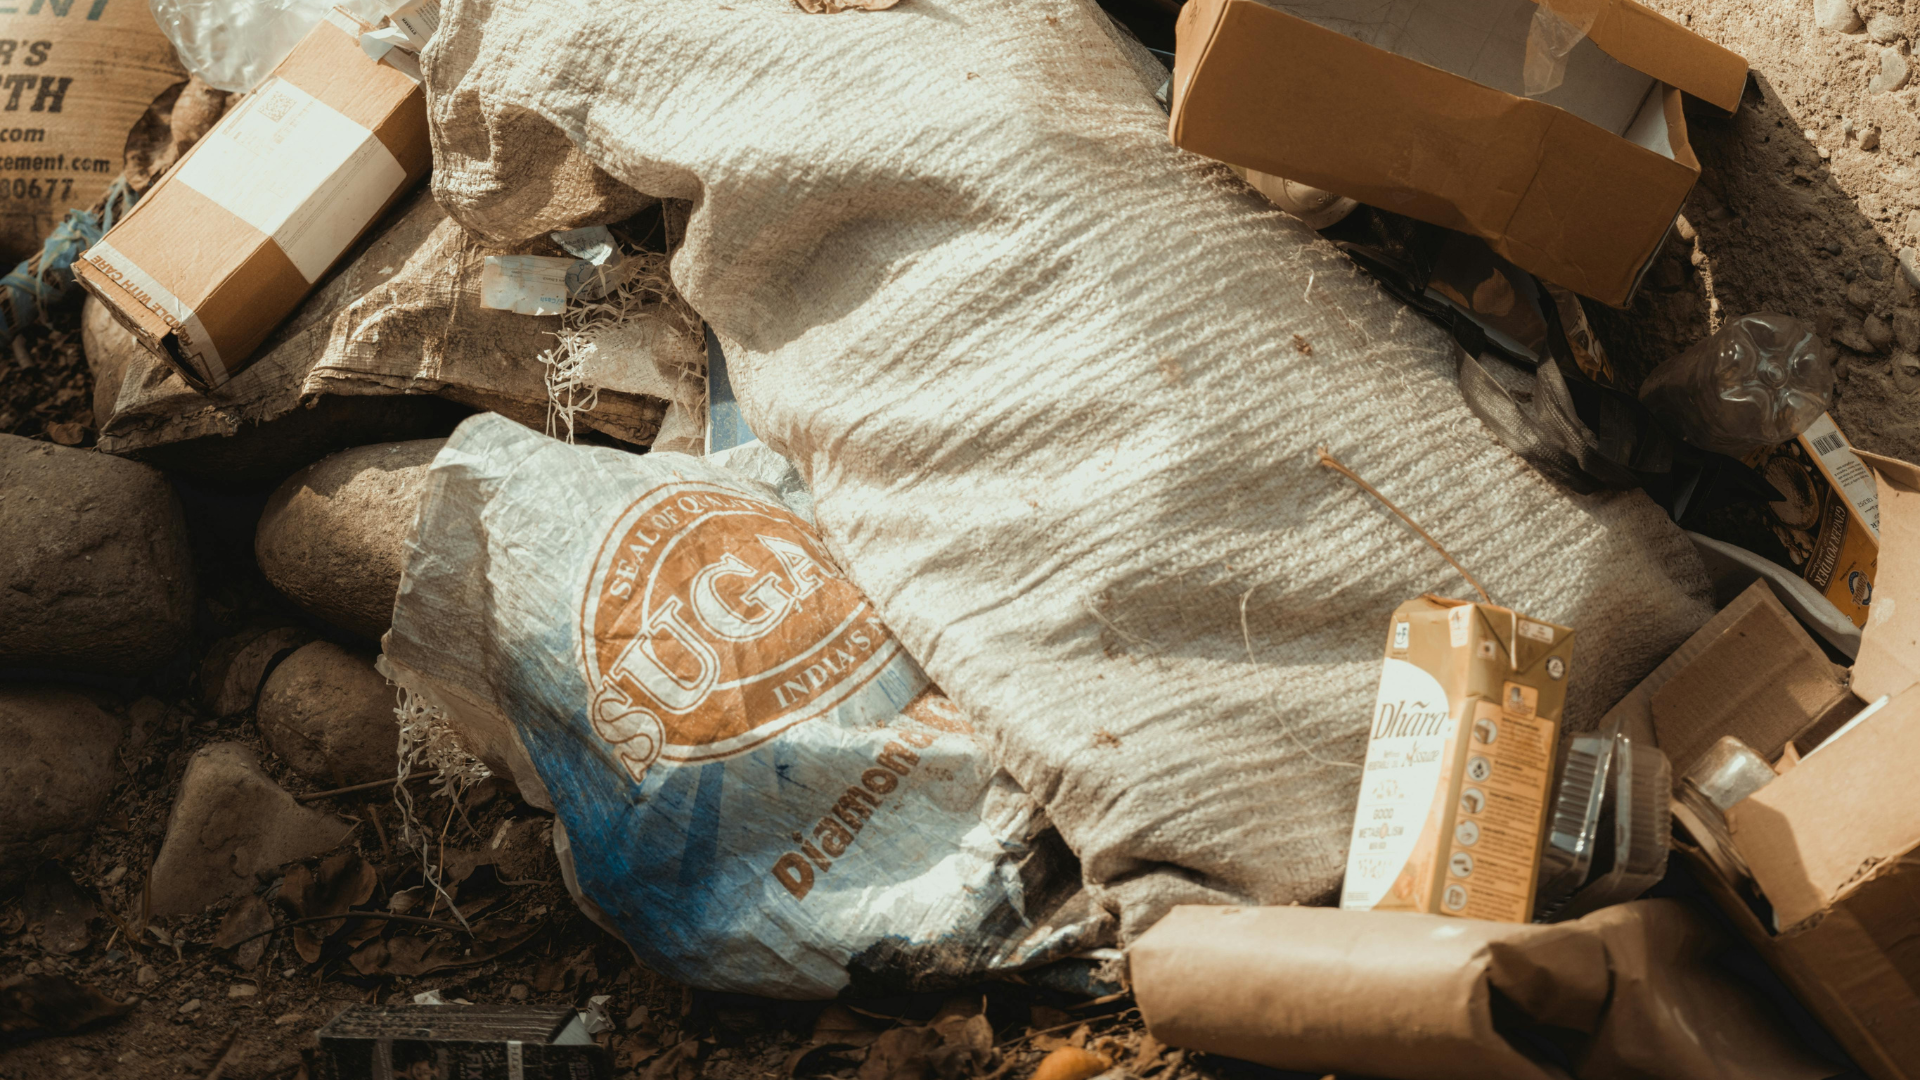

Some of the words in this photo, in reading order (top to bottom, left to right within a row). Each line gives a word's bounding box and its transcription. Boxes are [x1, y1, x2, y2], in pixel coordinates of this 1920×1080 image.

[0, 74, 73, 113] TH
[90, 255, 124, 281] CARE
[121, 279, 152, 305] WITH
[1829, 505, 1846, 543] GINGER
[609, 529, 661, 600] SEAL
[652, 506, 680, 530] OF
[1814, 541, 1839, 587] POWDER
[771, 629, 871, 709] INDIA'S
